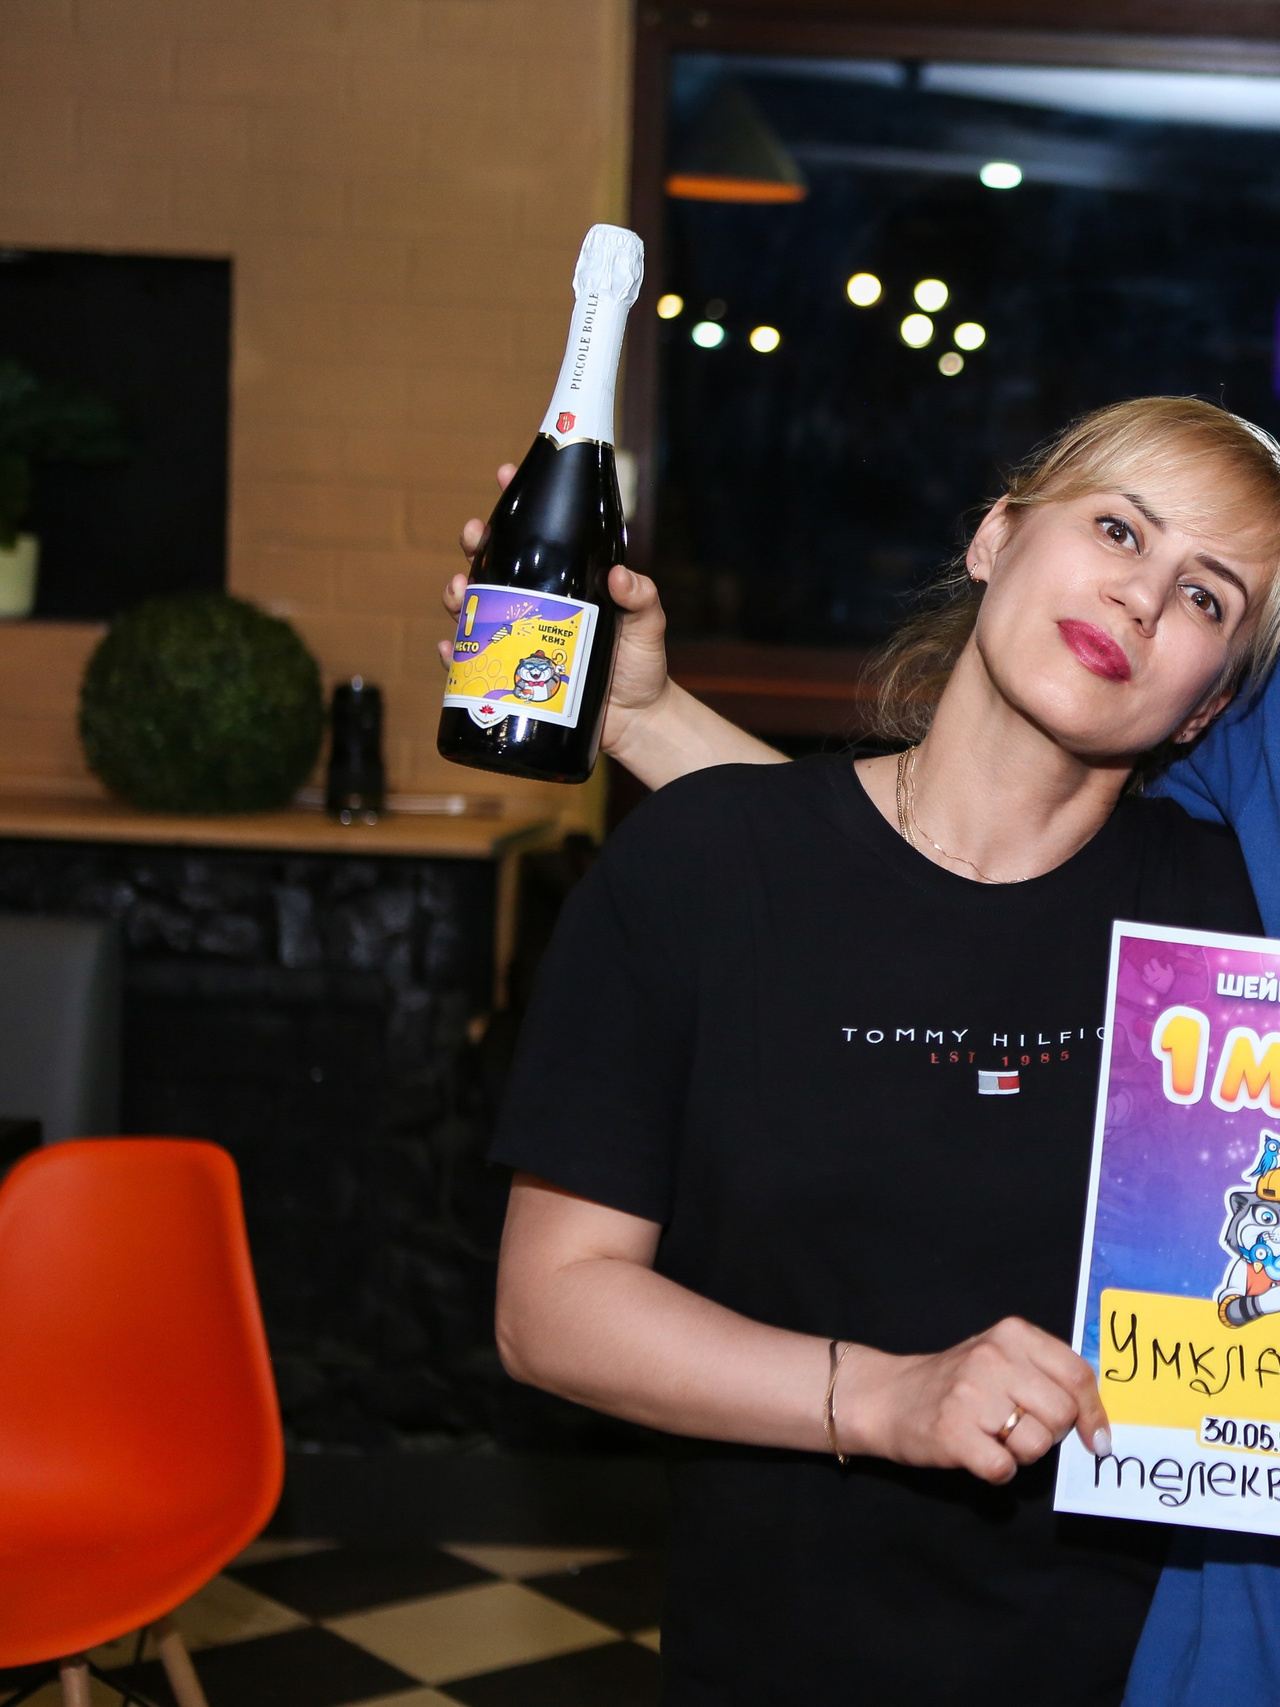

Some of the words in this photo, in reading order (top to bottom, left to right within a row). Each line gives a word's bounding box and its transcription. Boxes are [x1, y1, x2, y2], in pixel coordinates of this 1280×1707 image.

[570, 337, 591, 390] PICCOLE
[582, 292, 599, 333] BOLLE
[464, 594, 479, 638] 1
[538, 624, 574, 638] ШЕЙКЕР
[541, 635, 566, 646] КВИЗ
[842, 1028, 968, 1044] TOMMY
[930, 1051, 975, 1064] EST
[1001, 1051, 1070, 1067] 1985
[1157, 1011, 1205, 1100] 1
